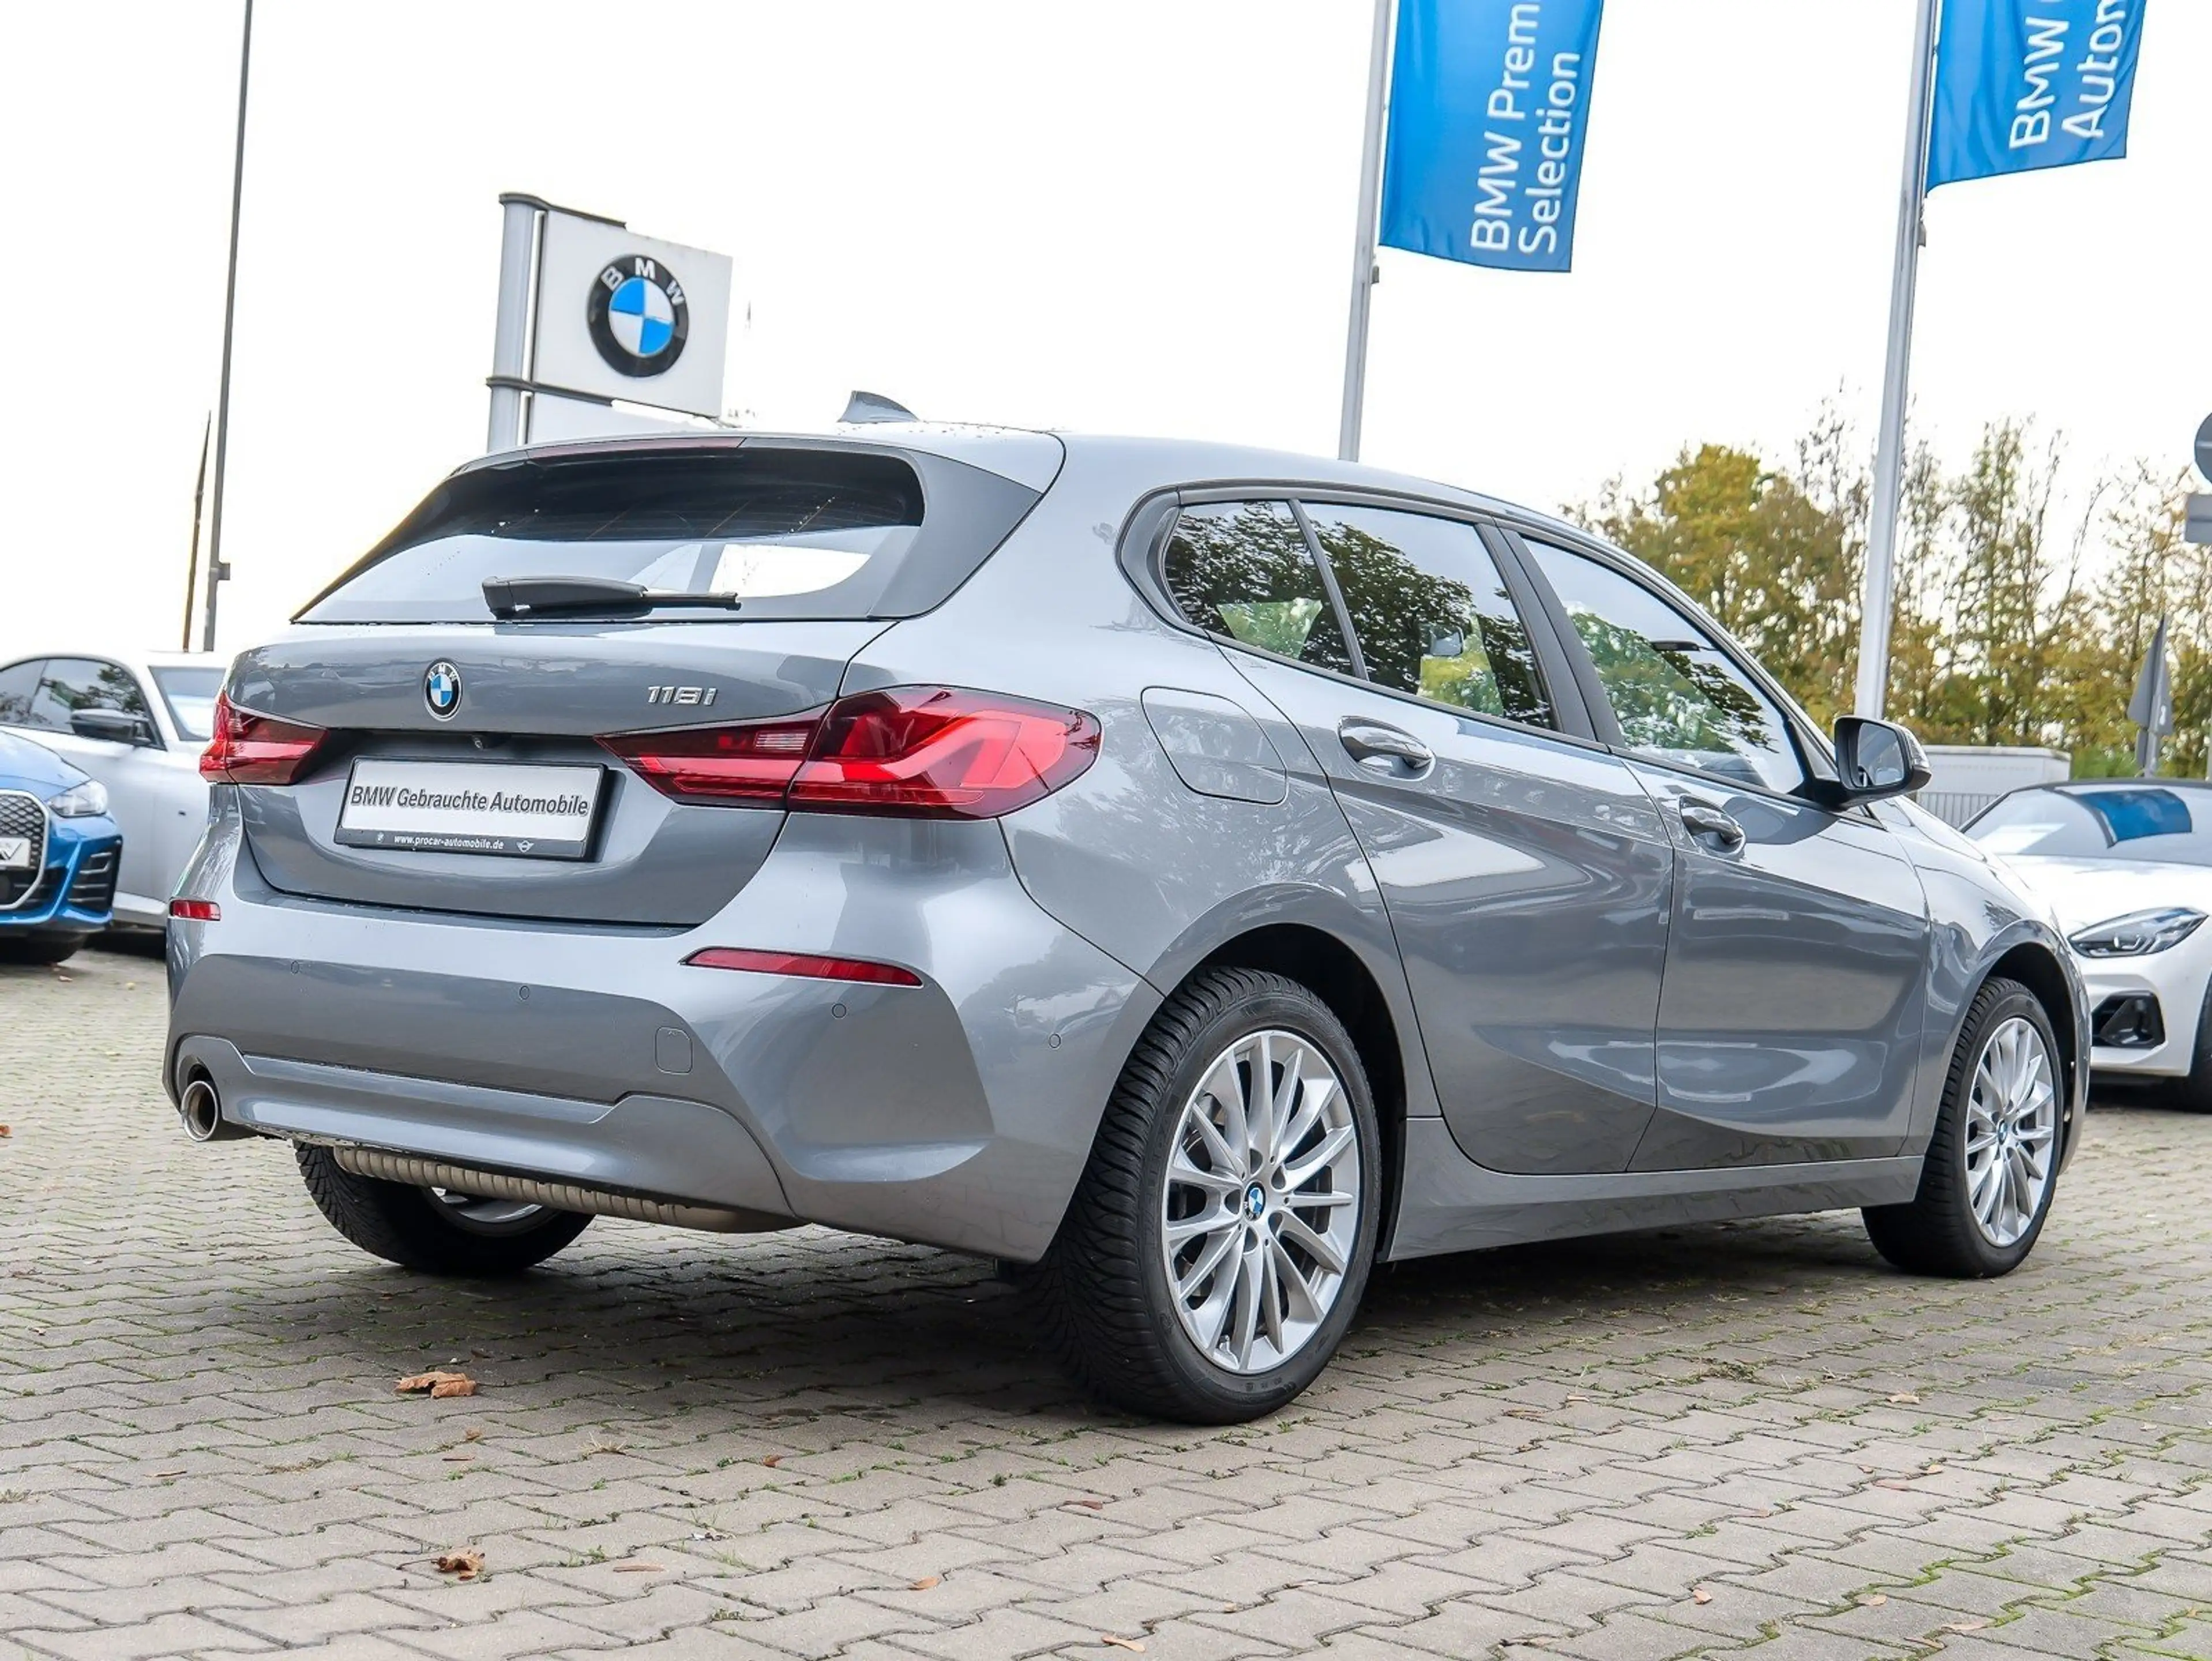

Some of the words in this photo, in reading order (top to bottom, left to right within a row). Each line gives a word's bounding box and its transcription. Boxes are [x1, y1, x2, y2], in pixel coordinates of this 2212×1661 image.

[1487, 3, 1541, 120] Prem
[2009, 16, 2070, 150] BMW
[1470, 131, 1522, 251] BMW
[1518, 52, 1580, 254] Selection
[600, 257, 685, 306] BMW
[648, 685, 718, 707] 118i
[351, 786, 397, 806] BMW
[397, 787, 488, 810] Gebrauchte
[490, 791, 589, 817] Automobile
[394, 835, 505, 850] www.procar-automobile.de
